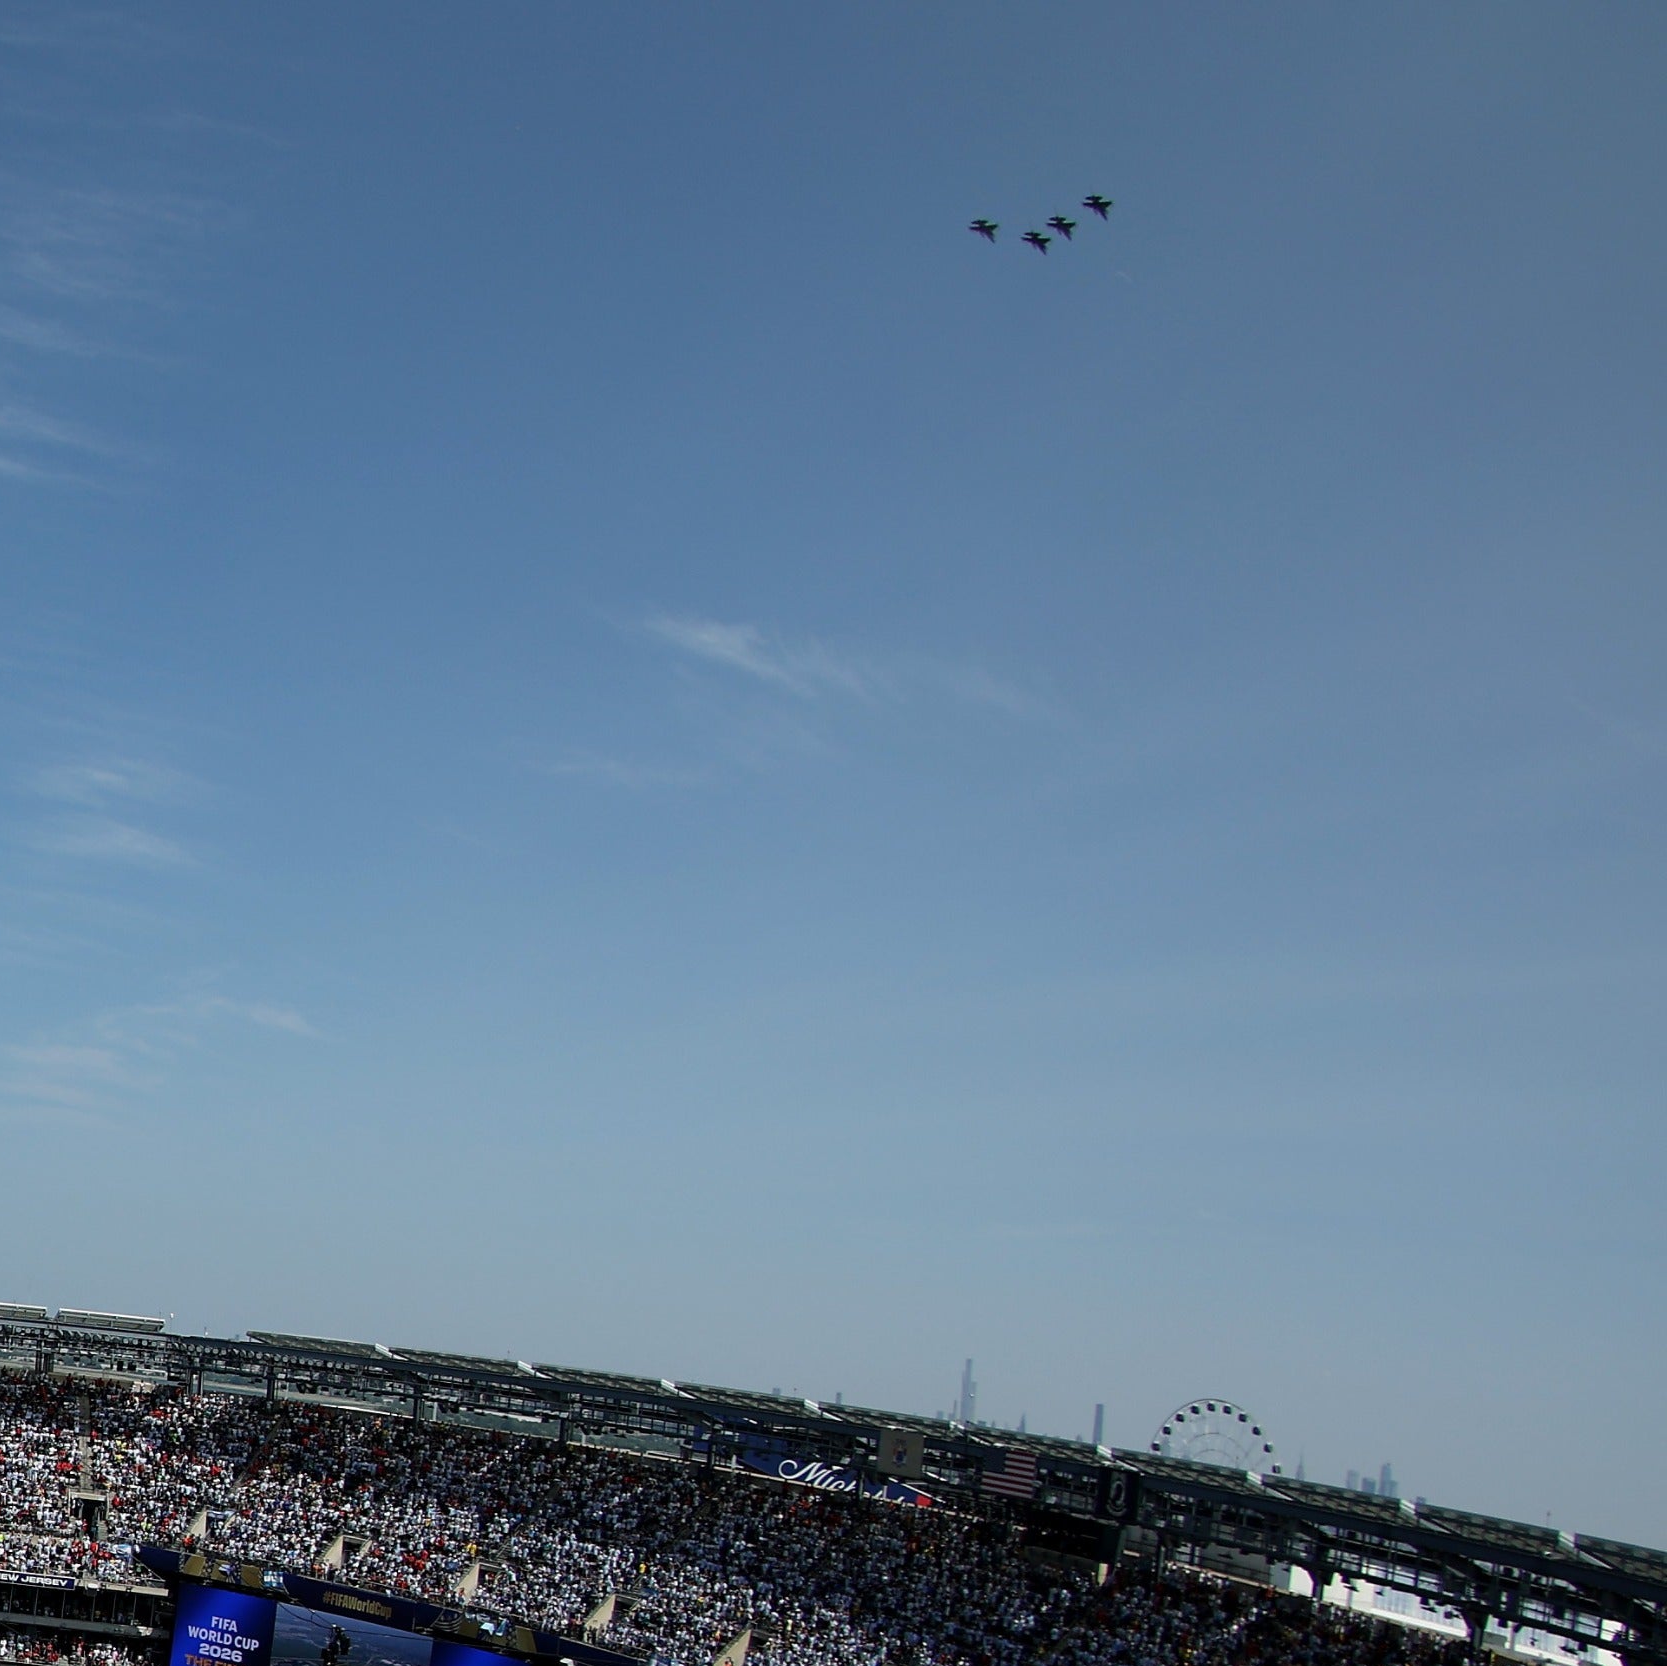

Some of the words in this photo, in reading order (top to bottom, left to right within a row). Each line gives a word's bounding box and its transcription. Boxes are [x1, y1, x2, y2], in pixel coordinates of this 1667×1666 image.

[20, 1574, 68, 1586] JERSEY
[322, 1591, 392, 1620] #FIFAWorldCup
[210, 1615, 238, 1633] FIFA
[187, 1624, 235, 1646] WORLD
[235, 1635, 260, 1652] CUP
[198, 1642, 244, 1663] 2026
